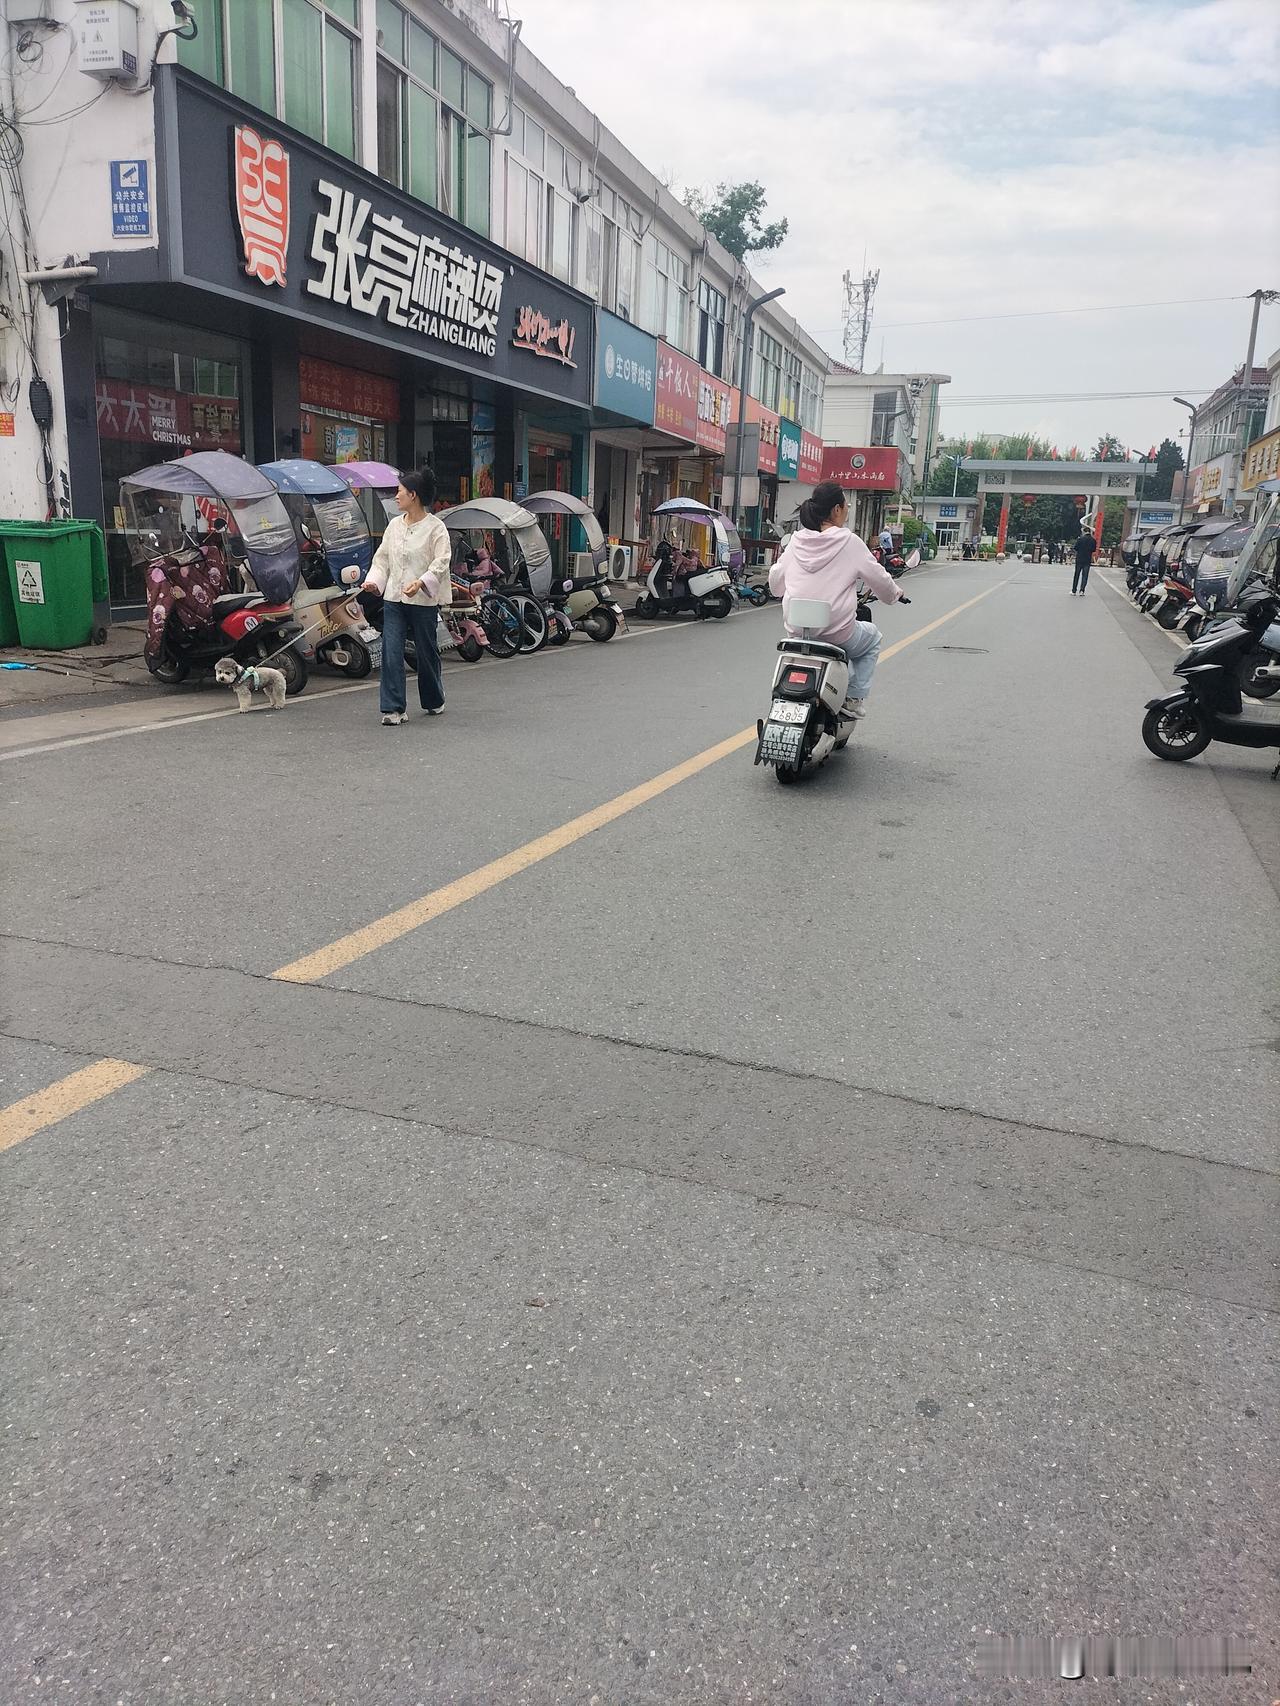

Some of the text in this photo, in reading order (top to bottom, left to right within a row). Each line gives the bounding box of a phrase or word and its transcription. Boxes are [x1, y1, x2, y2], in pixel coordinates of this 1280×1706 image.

[115, 190, 145, 201] 公共安全
[113, 202, 149, 214] 视频监控区域
[123, 215, 139, 223] VIDEO
[307, 179, 505, 336] 张亮麻辣烫
[407, 308, 497, 358] ZHANGLIANG
[151, 415, 177, 430] MERRY
[152, 430, 192, 446] CHRISTMAS
